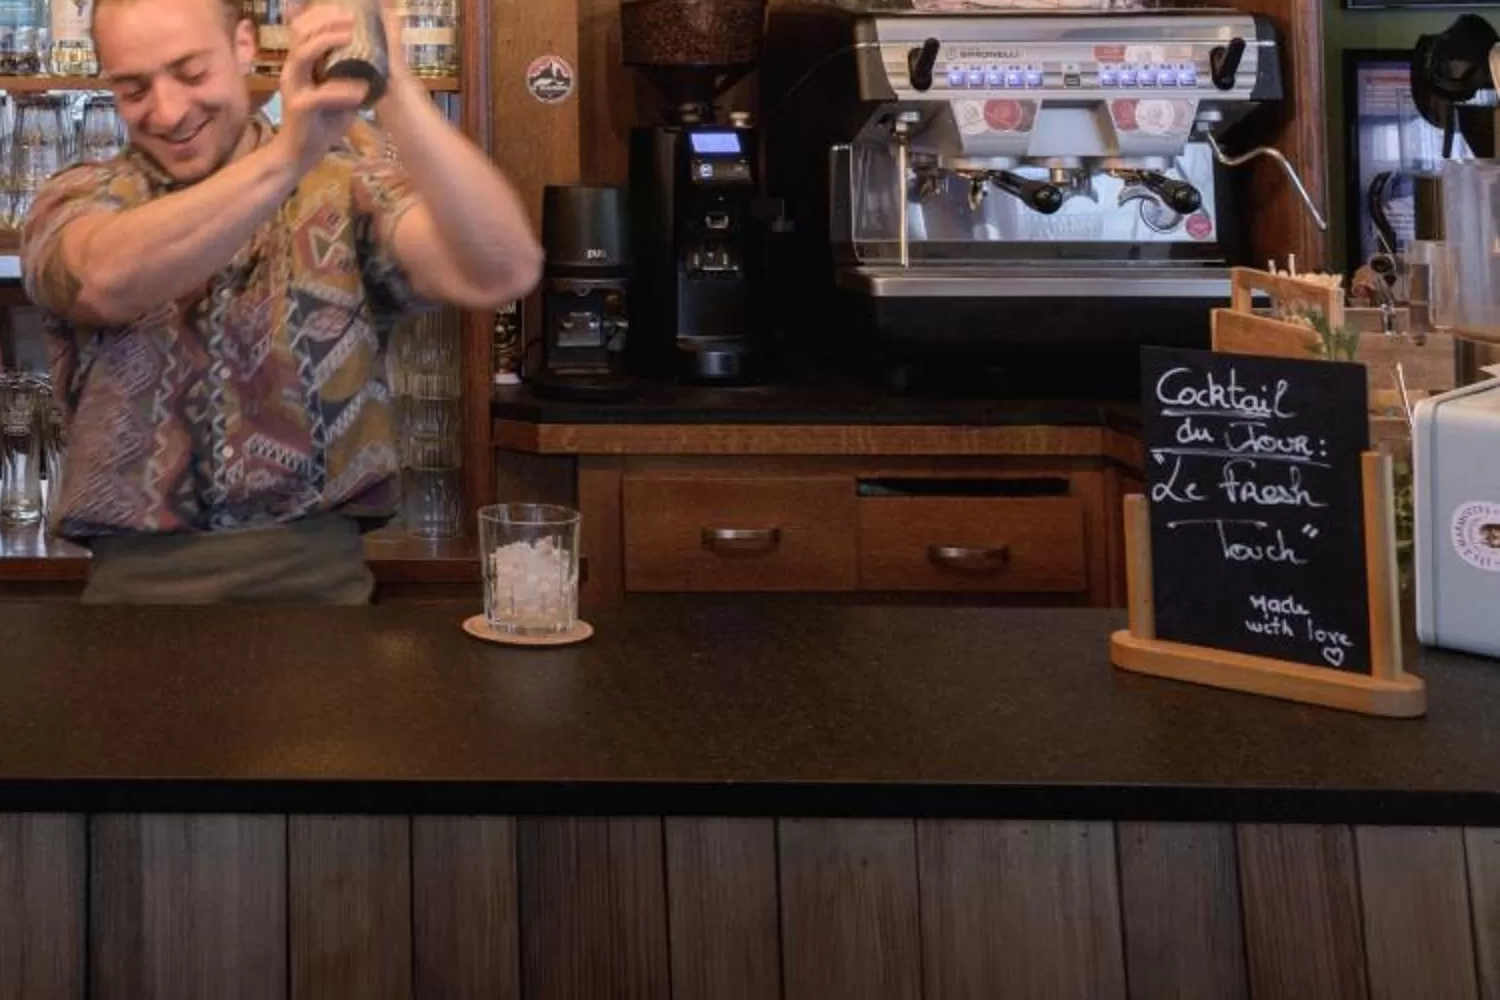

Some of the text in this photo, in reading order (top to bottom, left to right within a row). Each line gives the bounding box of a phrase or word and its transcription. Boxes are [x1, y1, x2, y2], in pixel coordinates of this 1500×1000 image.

[1156, 367, 1298, 419] Cocktail
[1176, 416, 1215, 444] du
[1245, 617, 1356, 647] with love
